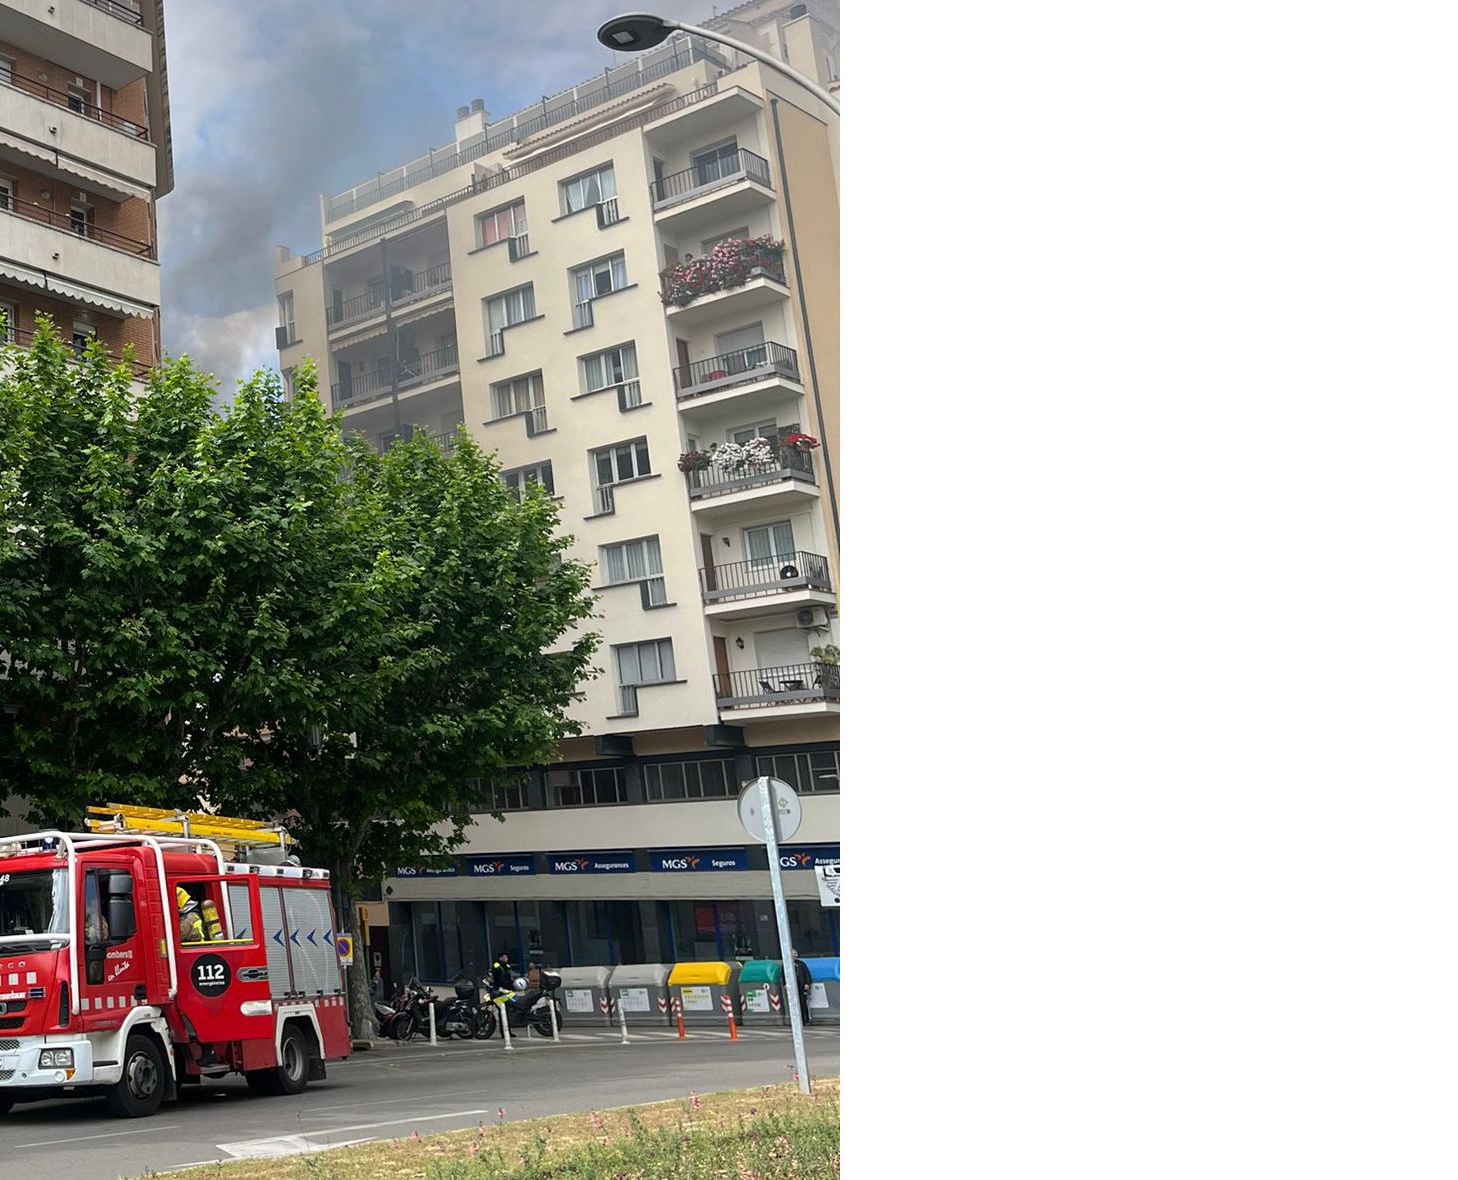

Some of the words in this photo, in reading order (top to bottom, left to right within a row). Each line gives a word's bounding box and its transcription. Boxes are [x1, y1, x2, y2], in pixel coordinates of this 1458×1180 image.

[555, 861, 577, 871] MGS
[593, 861, 629, 870] Assegurances
[662, 859, 688, 869] MGS
[711, 859, 736, 867] Seguros
[780, 857, 798, 867] GS
[473, 864, 494, 873] MGS
[509, 864, 530, 873] Seguros
[197, 964, 225, 980] 112
